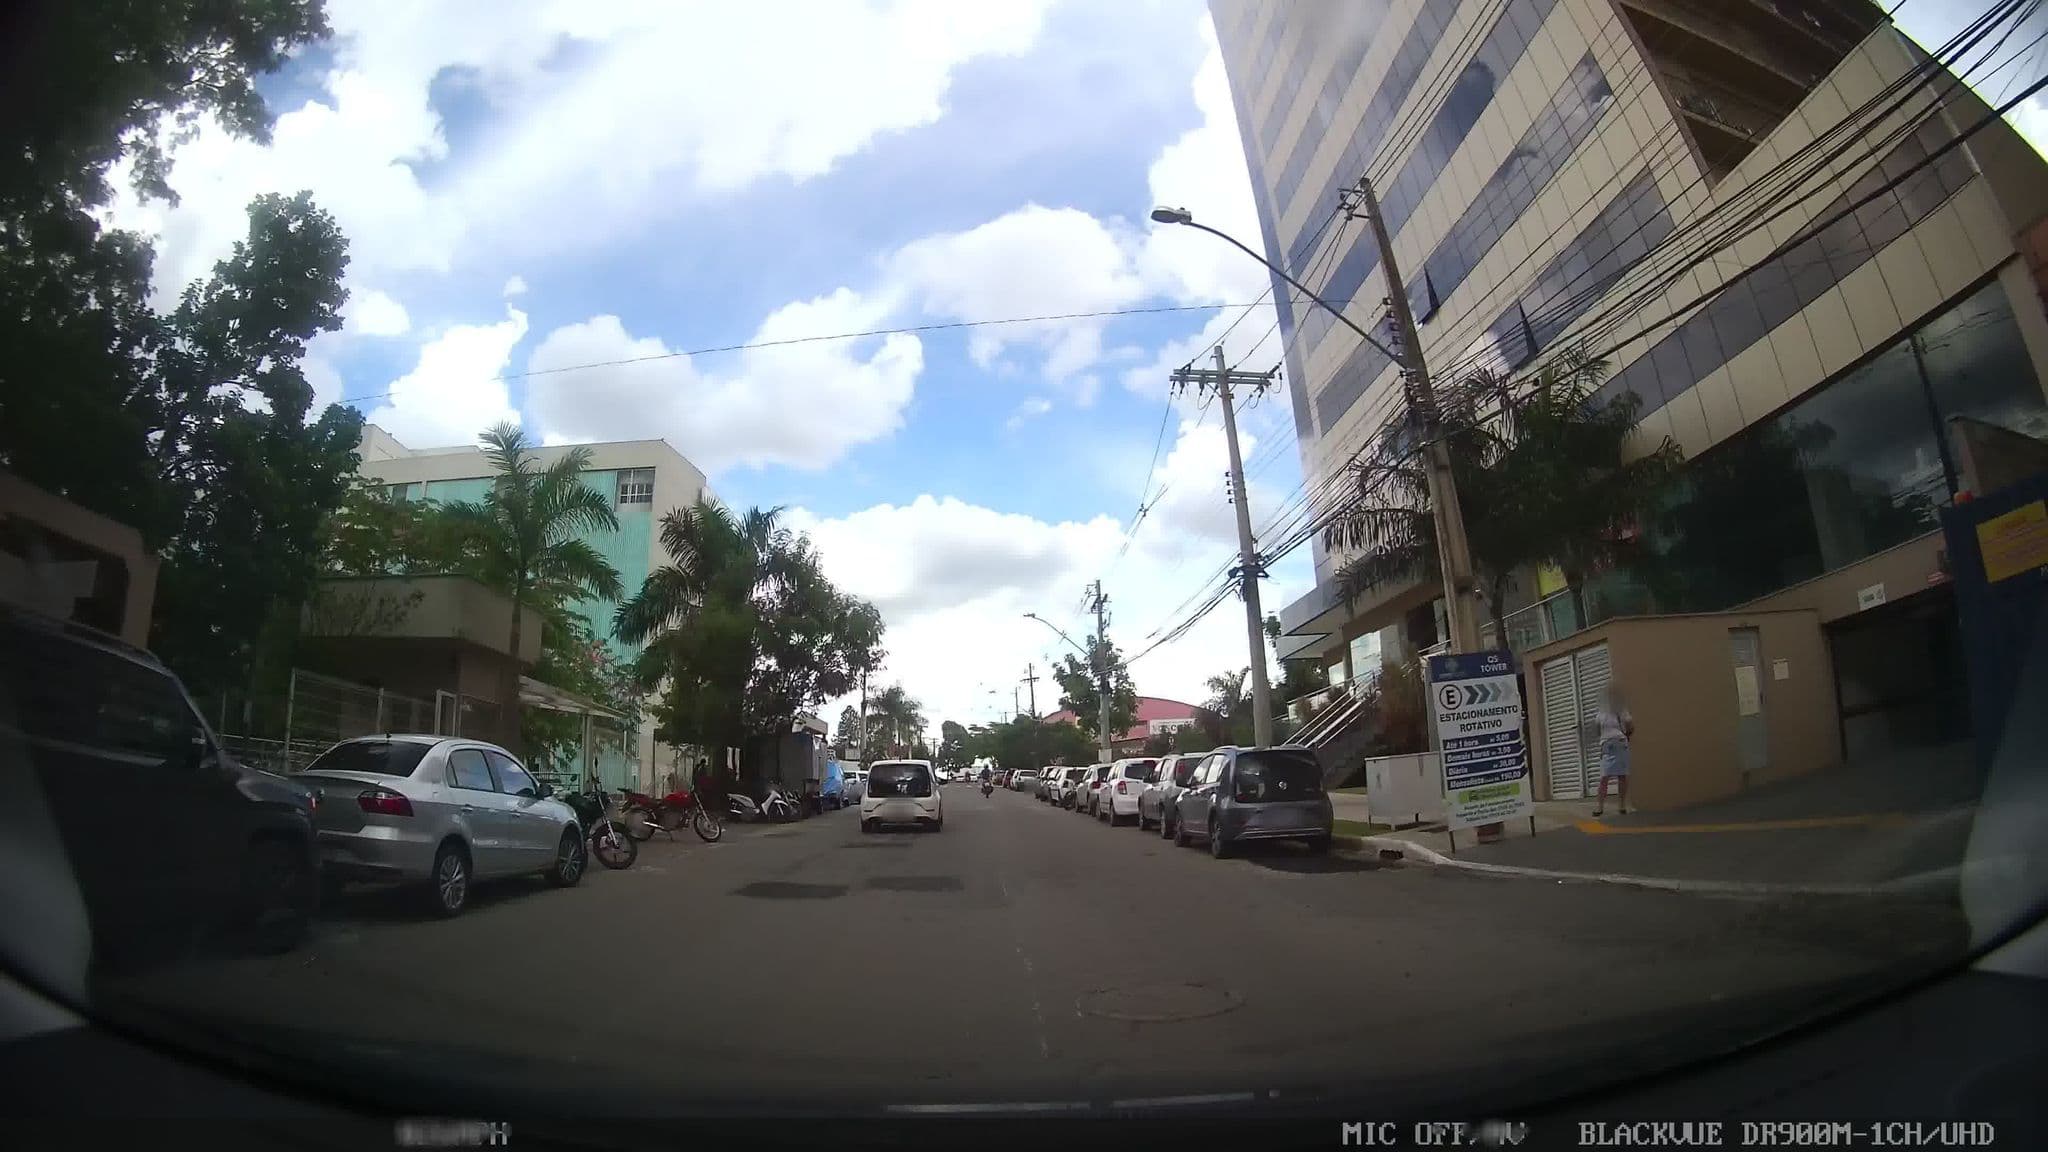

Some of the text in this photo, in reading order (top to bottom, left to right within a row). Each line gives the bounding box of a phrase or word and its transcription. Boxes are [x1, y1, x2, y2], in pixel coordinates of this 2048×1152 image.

[1480, 663, 1507, 673] TOWER
[1446, 690, 1456, 705] E
[1440, 705, 1518, 722] ESTACIONAMENTO
[1460, 719, 1502, 732] ROTATIVO
